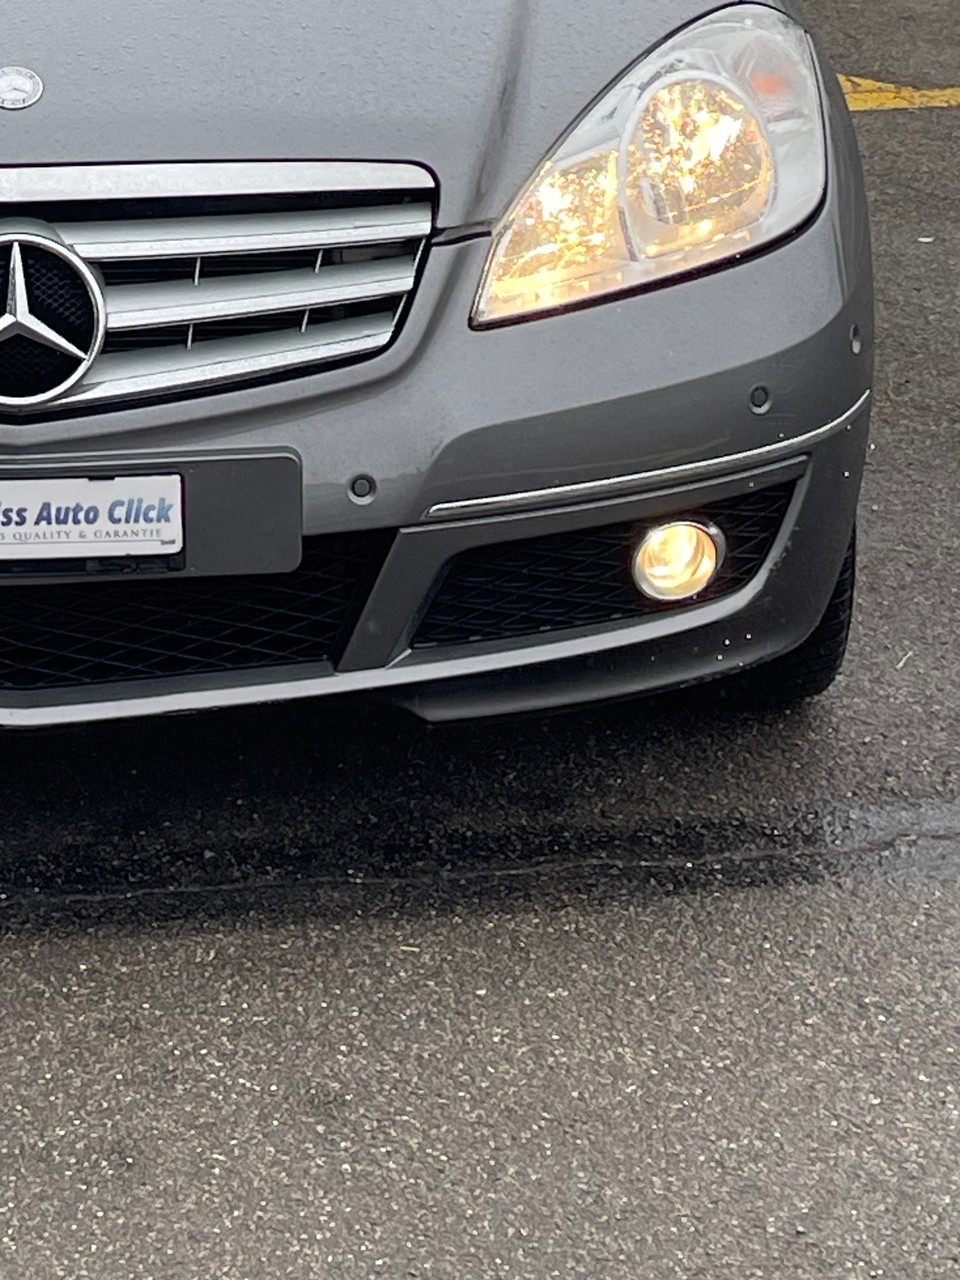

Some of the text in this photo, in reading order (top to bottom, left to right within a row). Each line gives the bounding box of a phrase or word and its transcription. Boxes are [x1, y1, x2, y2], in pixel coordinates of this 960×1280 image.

[33, 500, 100, 527] Auto
[107, 497, 175, 525] Click
[12, 529, 73, 543] QUALITY
[78, 530, 88, 540] &
[93, 528, 163, 540] GARANTIE
